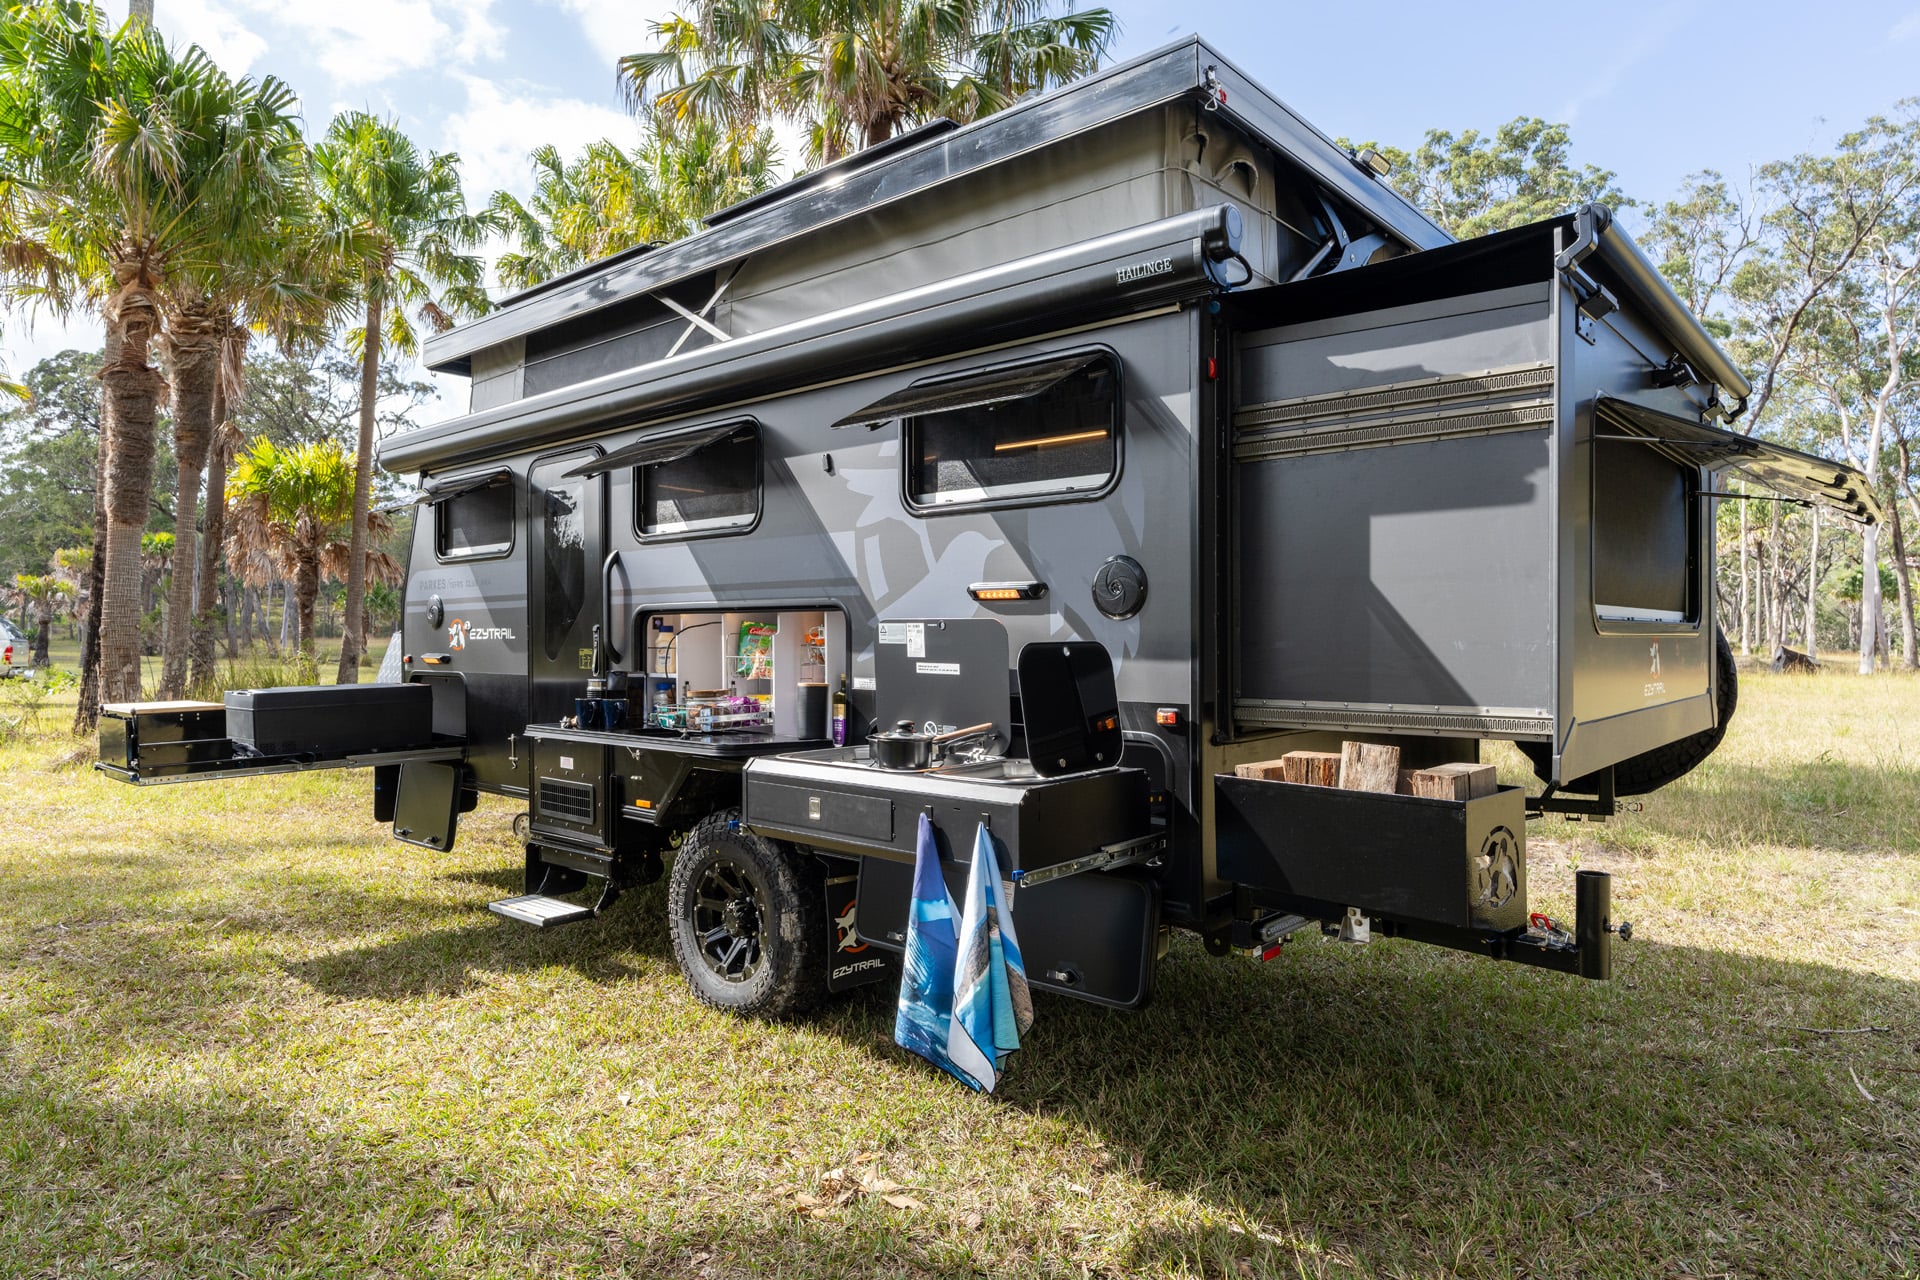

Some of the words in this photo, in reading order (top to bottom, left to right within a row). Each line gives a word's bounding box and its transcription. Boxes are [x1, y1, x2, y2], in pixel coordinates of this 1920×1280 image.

[1116, 257, 1172, 282] HAILINGE
[469, 627, 516, 640] EZYTRAIL
[832, 958, 886, 980] EZYTRAIL
